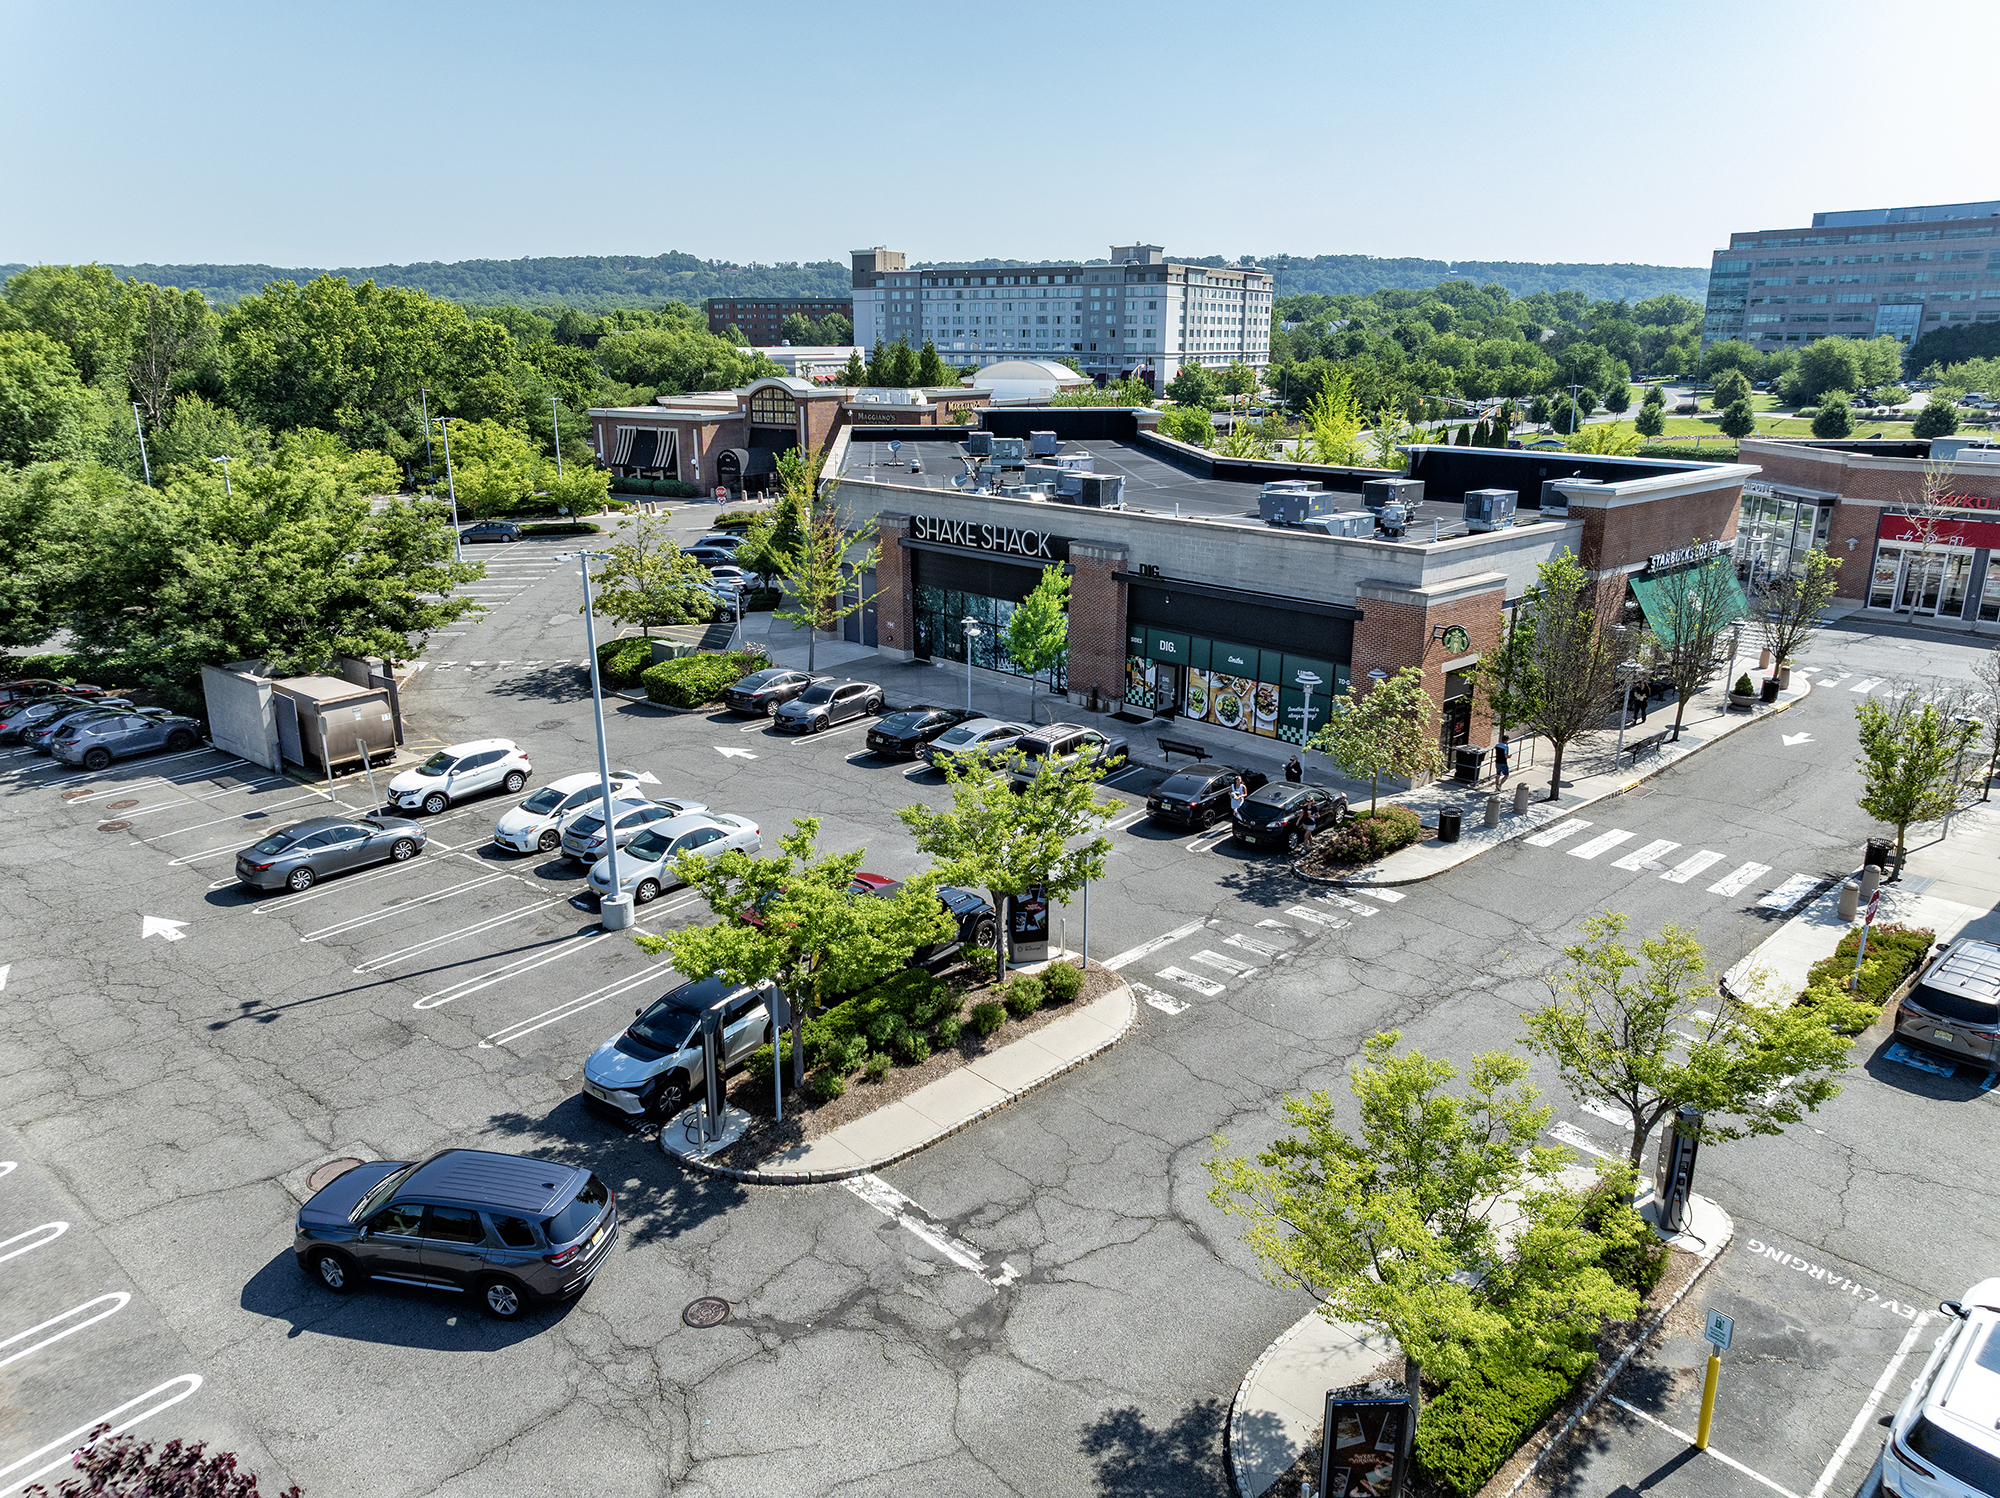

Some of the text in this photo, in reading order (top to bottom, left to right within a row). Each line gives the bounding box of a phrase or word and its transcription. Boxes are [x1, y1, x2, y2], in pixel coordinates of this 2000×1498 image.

[1744, 482, 1775, 494] HIPOTLE
[915, 514, 1052, 558] SHAKE SHACK
[1650, 546, 1694, 568] STARBUCKS
[1160, 640, 1177, 653] DIG.
[1746, 1239, 1917, 1320] EV CHARGING
